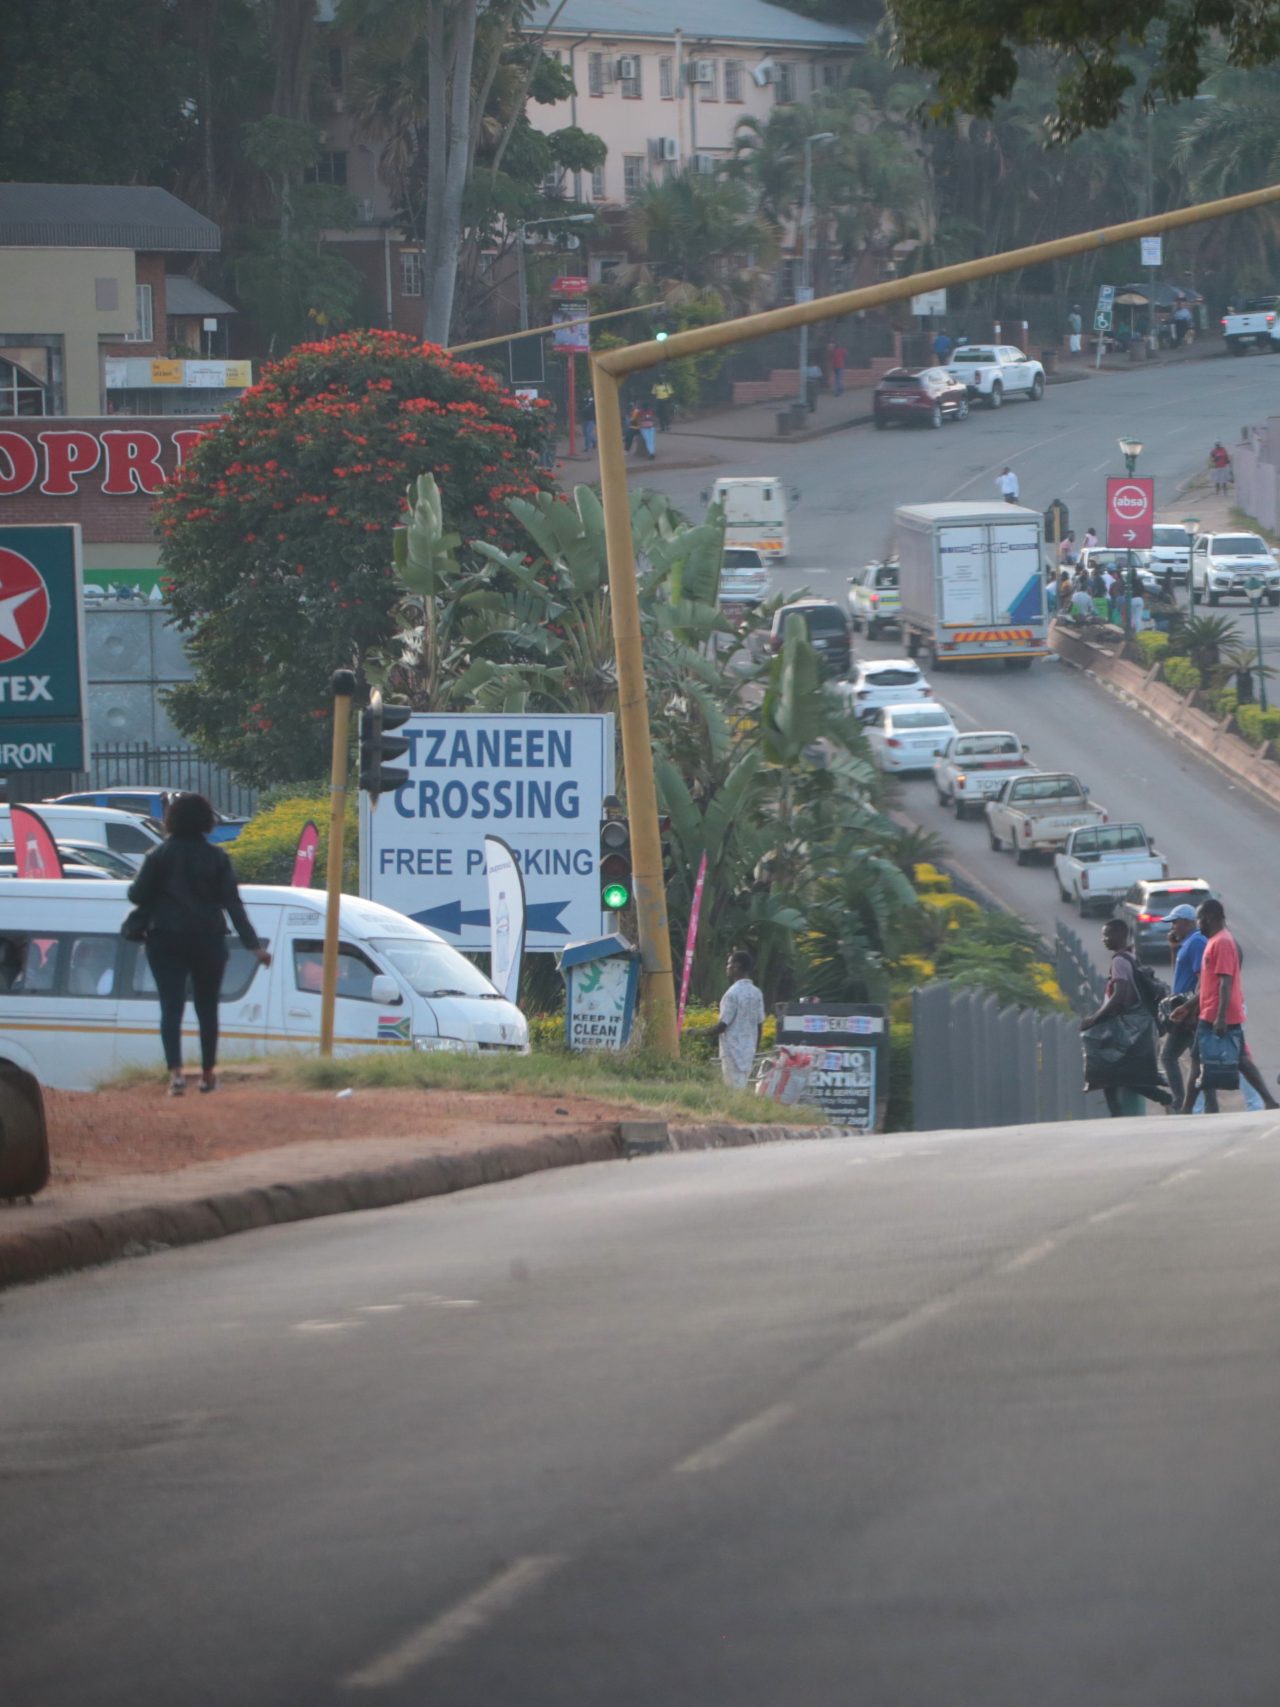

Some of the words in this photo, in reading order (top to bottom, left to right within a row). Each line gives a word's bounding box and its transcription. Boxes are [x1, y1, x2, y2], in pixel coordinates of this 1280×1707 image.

[1117, 495, 1143, 507] absa
[0, 743, 53, 768] RON
[402, 729, 571, 768] TZANEEN
[394, 779, 579, 819] CROSSING
[379, 849, 453, 875] FREE
[466, 849, 593, 875] PKING
[573, 1013, 606, 1022] KEEP
[610, 1015, 621, 1023] IT
[574, 1023, 617, 1037] CLEAN
[574, 1037, 602, 1045] KEEP
